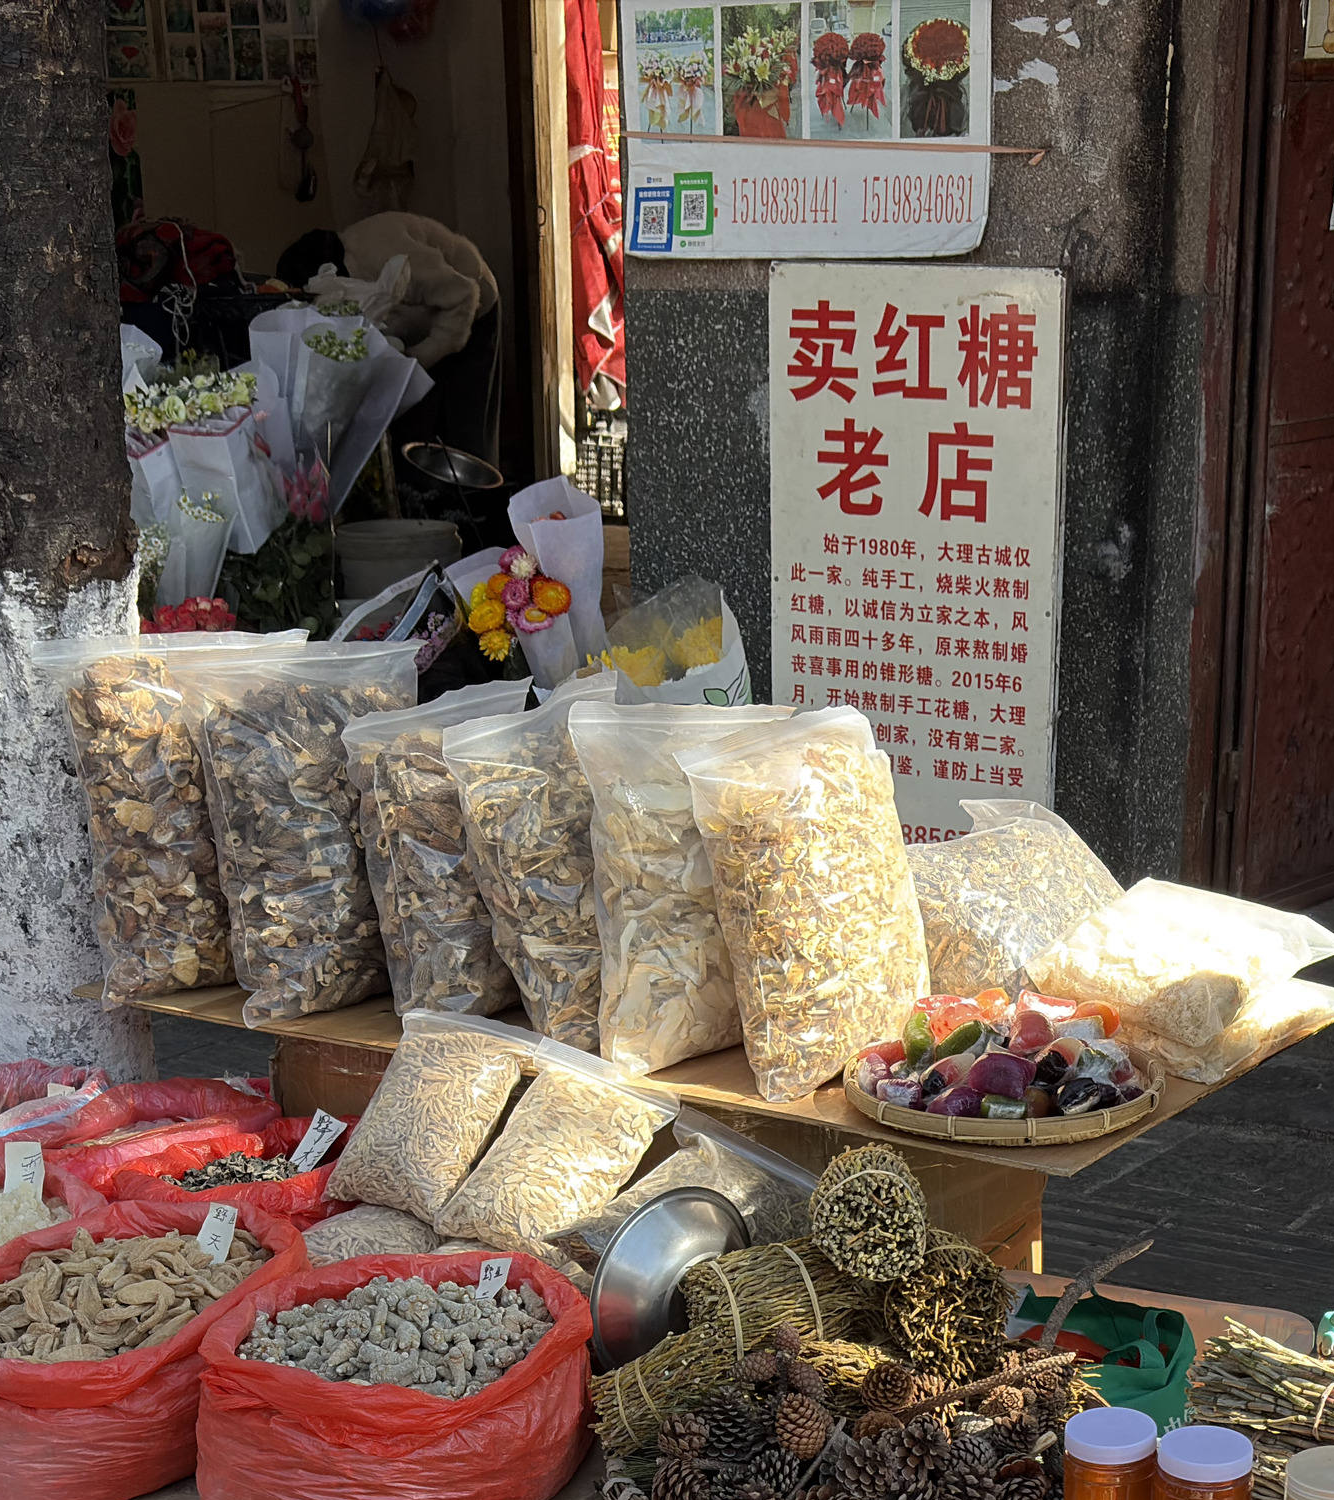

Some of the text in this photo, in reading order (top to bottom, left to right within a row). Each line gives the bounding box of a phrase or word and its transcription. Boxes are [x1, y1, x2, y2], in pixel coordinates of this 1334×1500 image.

[731, 173, 973, 224] 15198331441 15198346631
[787, 299, 1039, 410] 卖红糖
[816, 417, 994, 523] 老店
[823, 533, 1031, 568] 始于1980年，大理古城仅
[790, 562, 1029, 600] 此一家。纯手工，烧柴火熬制
[790, 593, 1029, 632] 红糖，以诚信为立家之本，风
[791, 624, 1028, 664] 风雨雨四十多年，原来熬制婚
[791, 654, 1023, 694] 丧喜事用的锥形糖。2015年6
[791, 684, 1026, 726] 月，开始熬制手工花糖，大理
[871, 722, 1025, 758] 创家，没有第二家。
